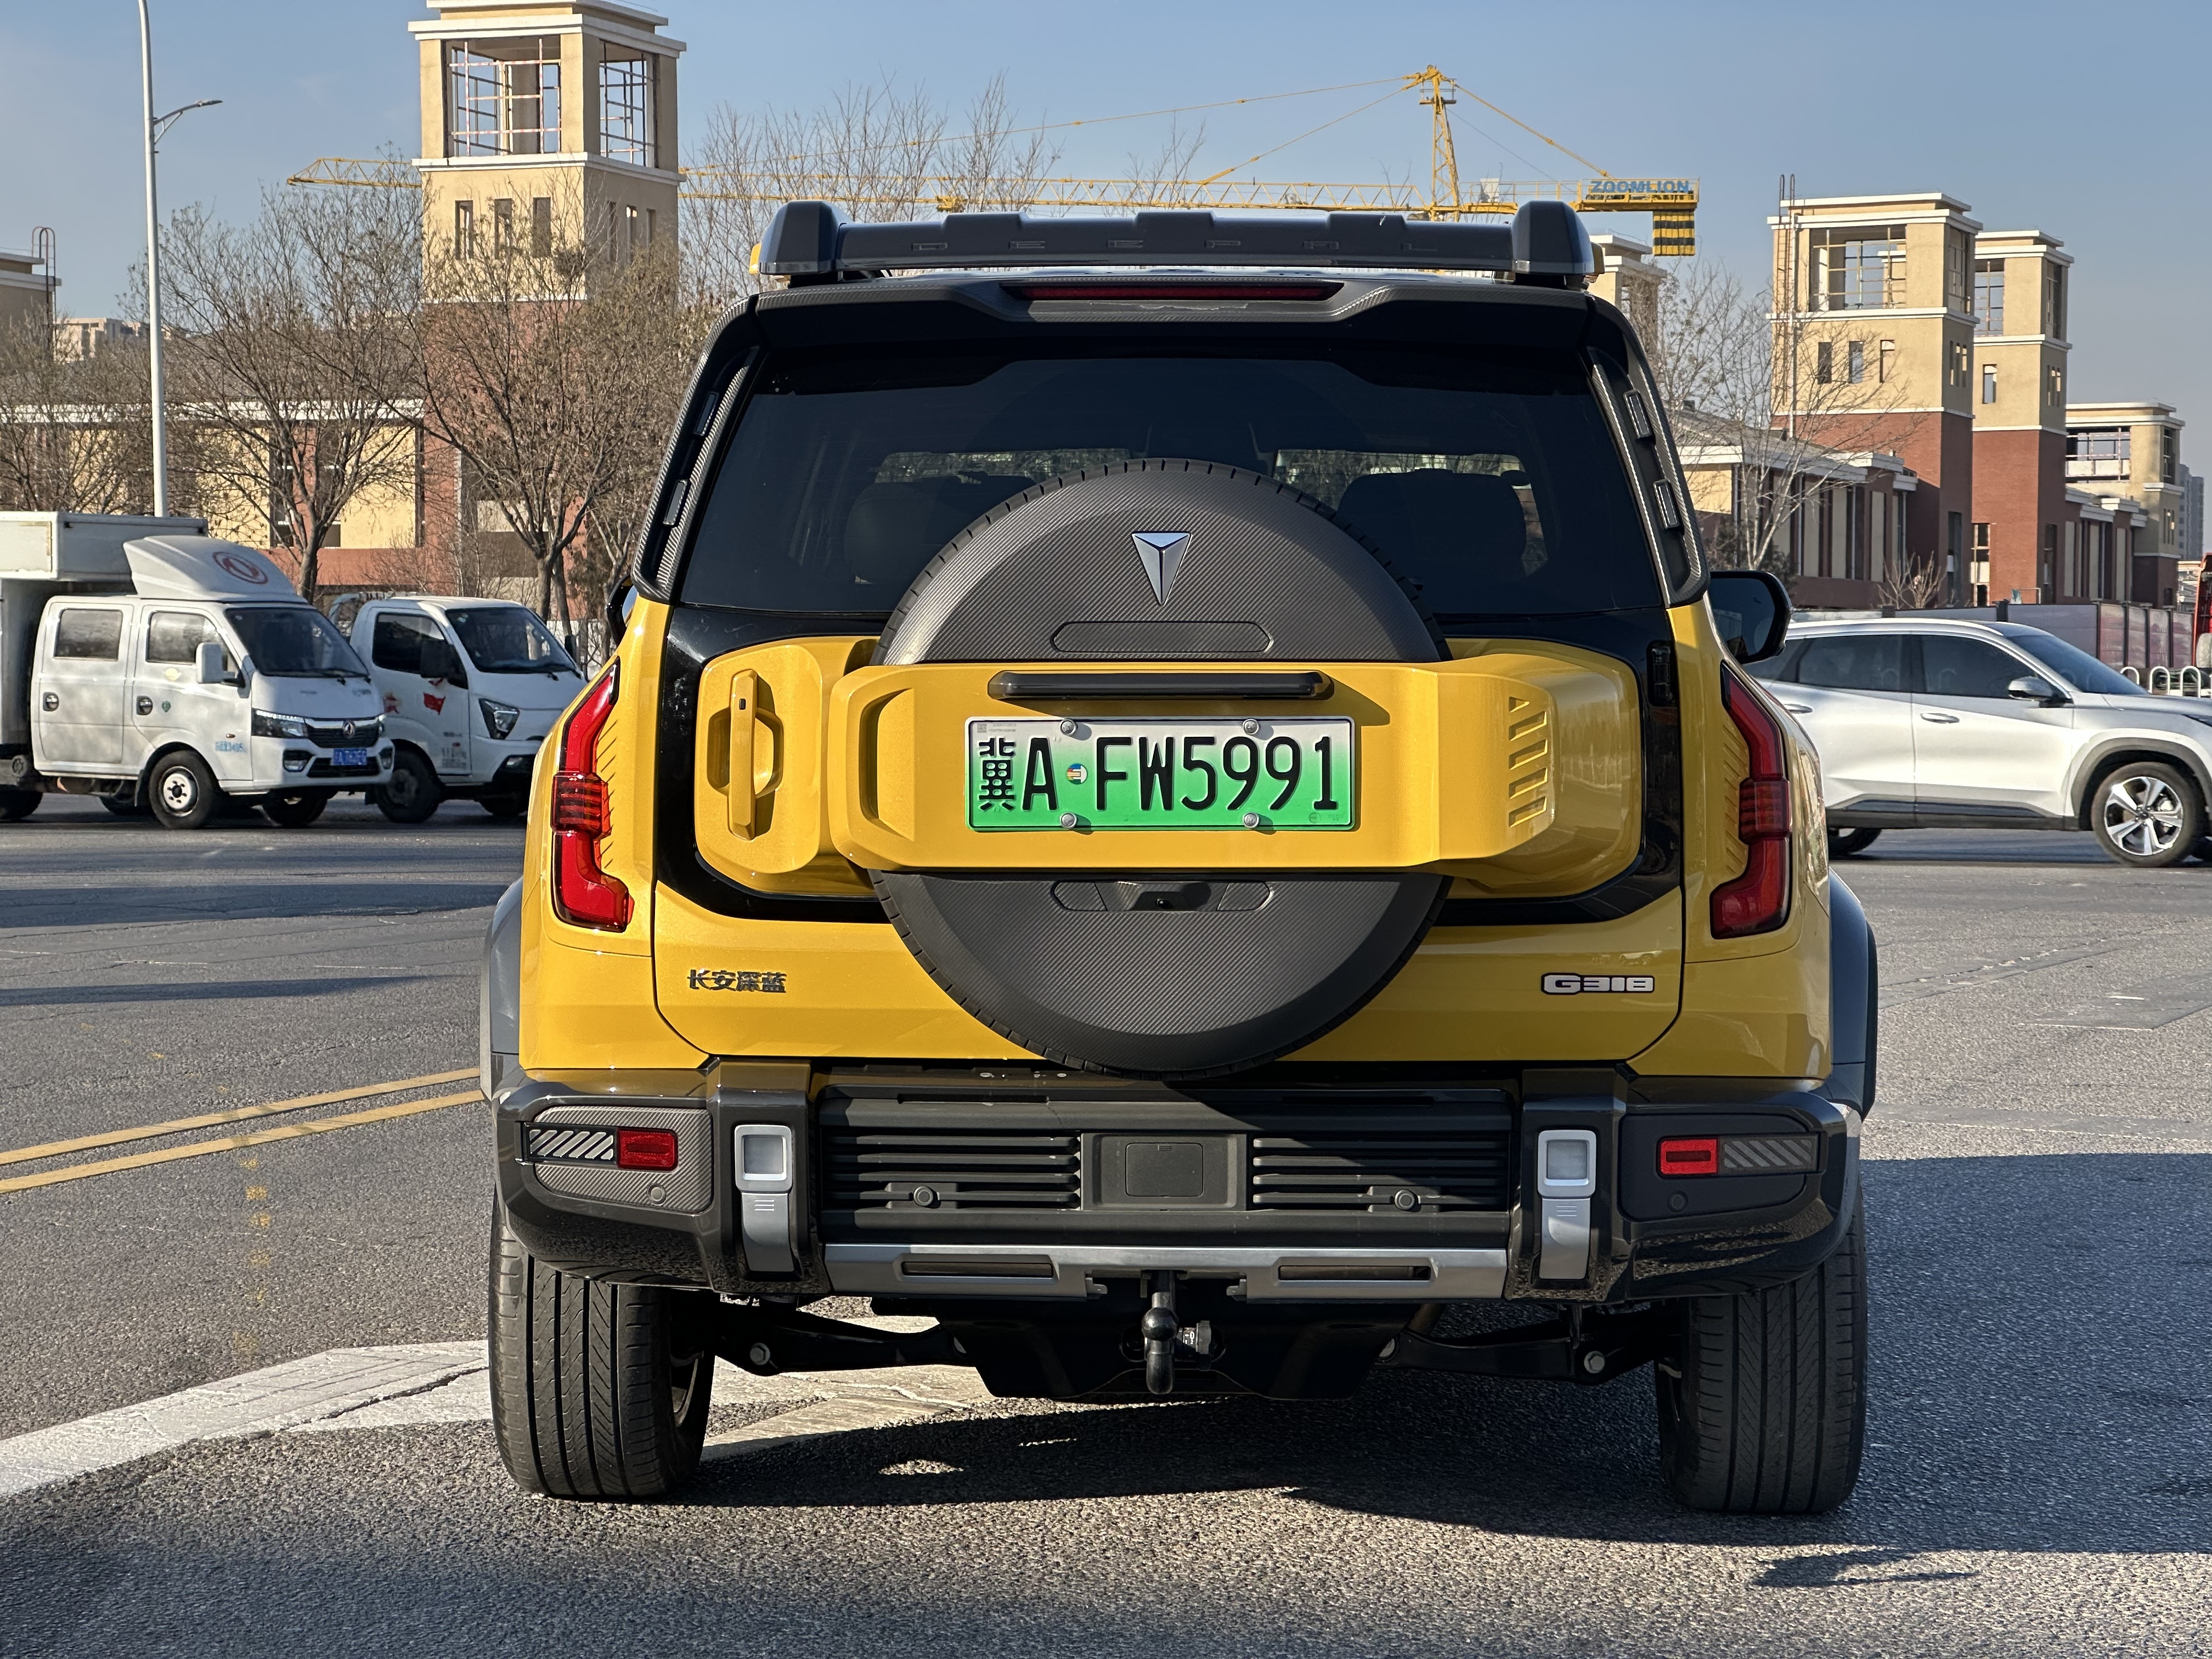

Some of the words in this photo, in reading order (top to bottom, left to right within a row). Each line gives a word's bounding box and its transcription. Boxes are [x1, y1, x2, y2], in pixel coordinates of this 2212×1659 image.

[1592, 180, 1689, 193] ZOOMLION
[1096, 736, 1339, 811] FW5991
[687, 969, 787, 993] 长安深蓝
[1542, 973, 1654, 995] G318
